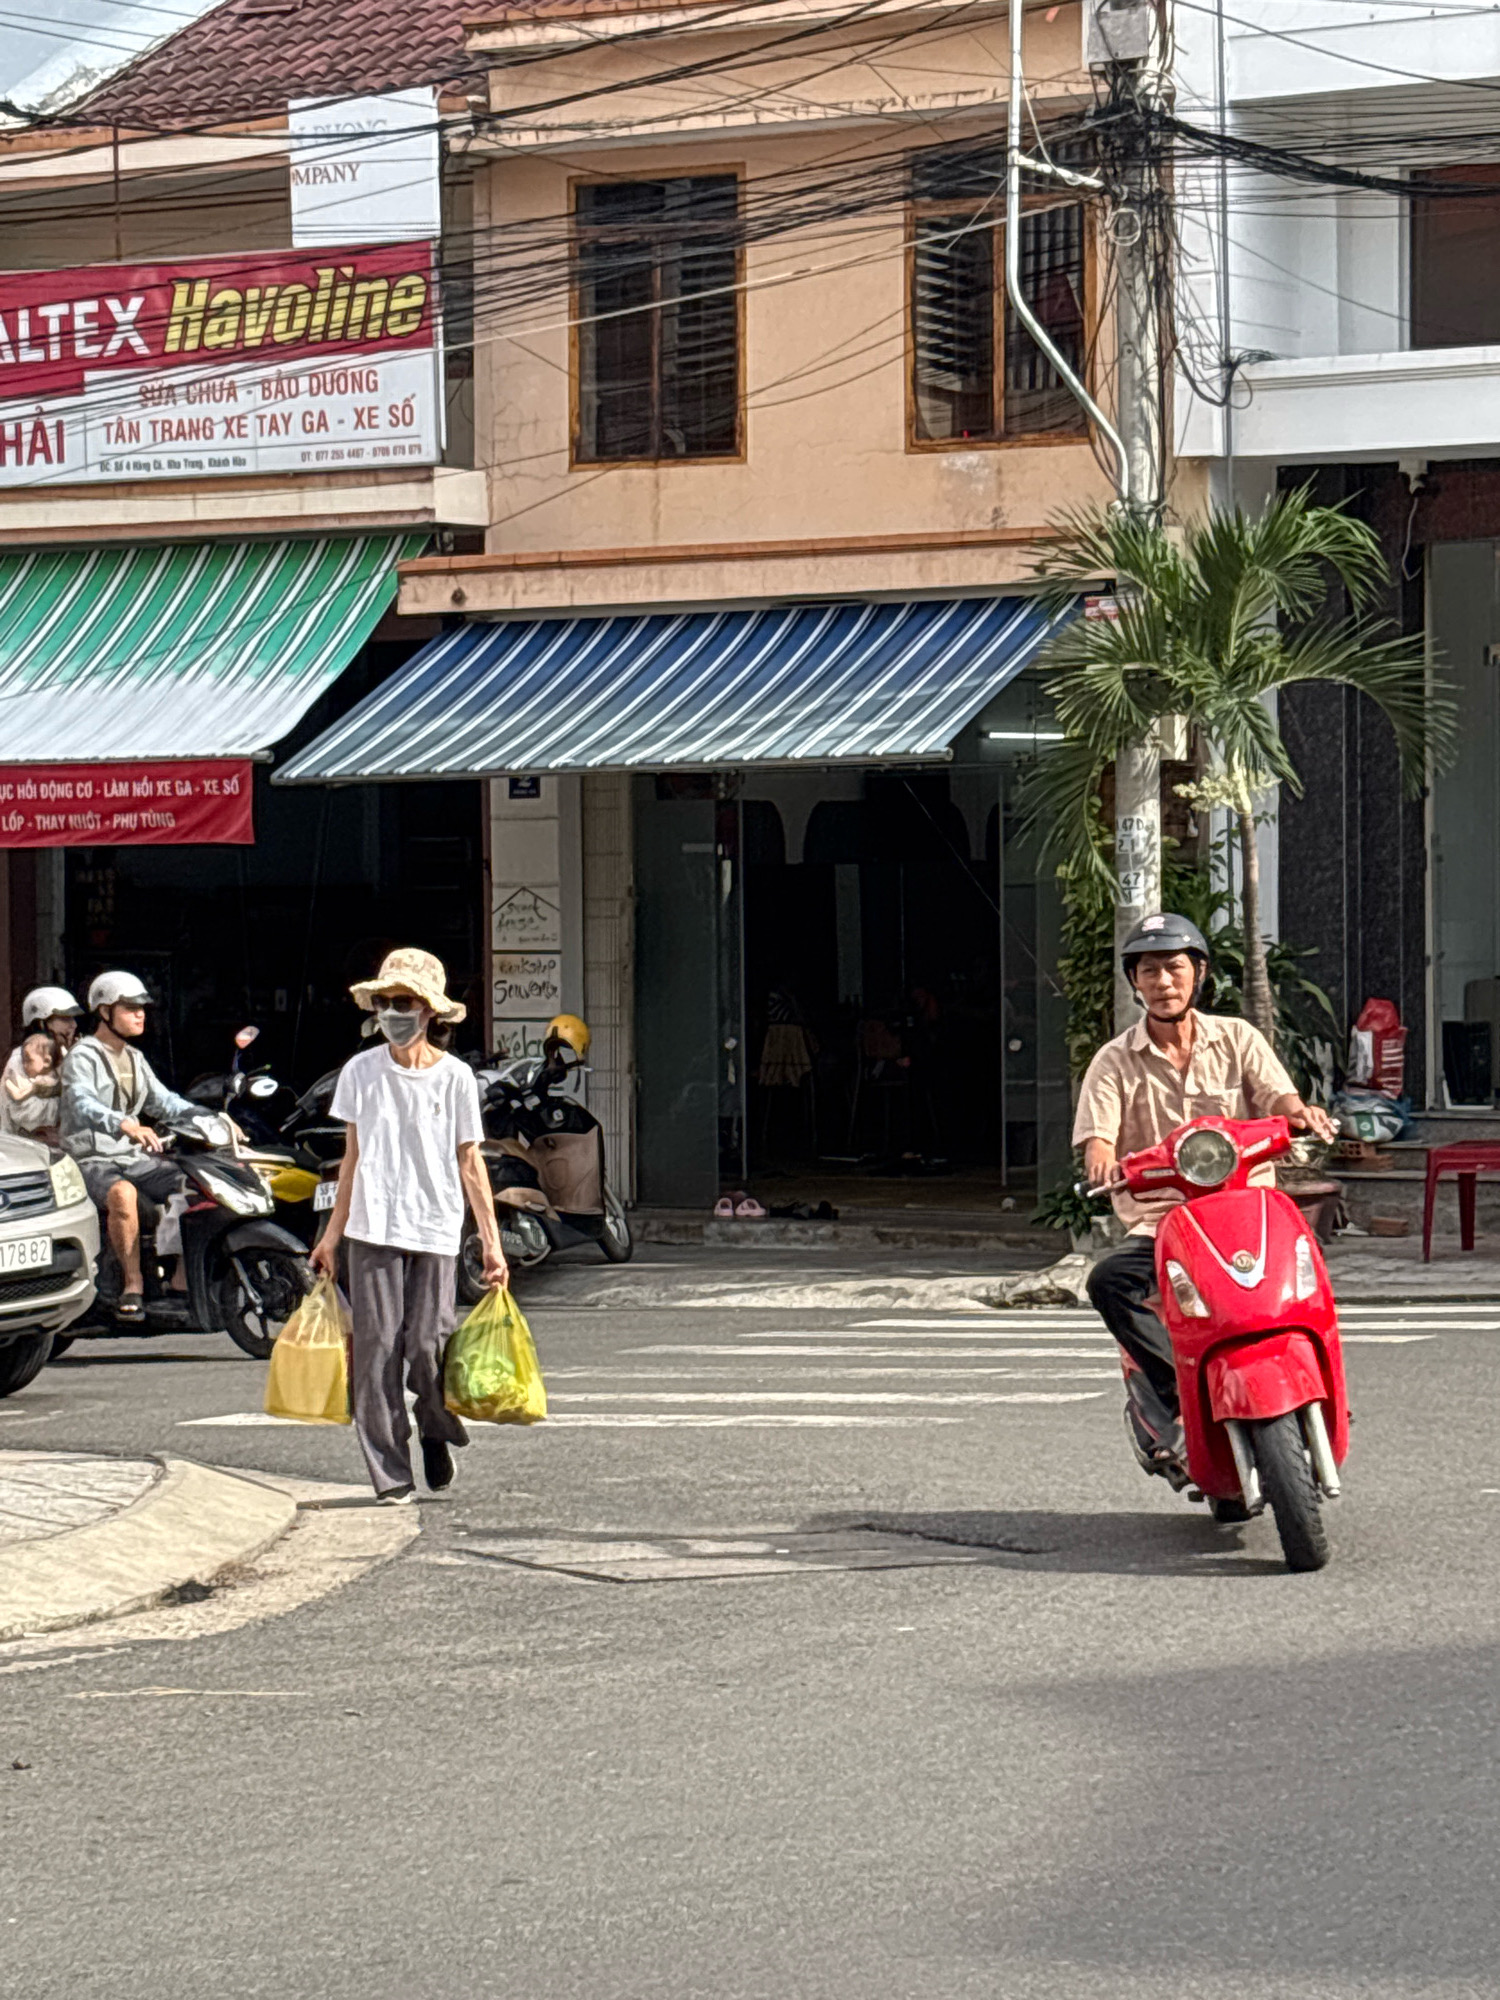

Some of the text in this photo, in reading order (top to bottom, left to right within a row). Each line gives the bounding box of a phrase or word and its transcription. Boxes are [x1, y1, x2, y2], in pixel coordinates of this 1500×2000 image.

[163, 266, 427, 353] Havoline
[103, 416, 141, 444] TÂN
[149, 416, 215, 442] TRANG
[223, 414, 249, 439] XE
[256, 411, 293, 437] TAY
[302, 409, 330, 434] GA
[353, 405, 380, 430] XE
[388, 393, 416, 428] SỐ
[156, 780, 172, 796] XE
[175, 780, 193, 796] GA
[203, 780, 221, 796] XE
[222, 773, 240, 795] SỐ
[34, 814, 66, 831] THAY
